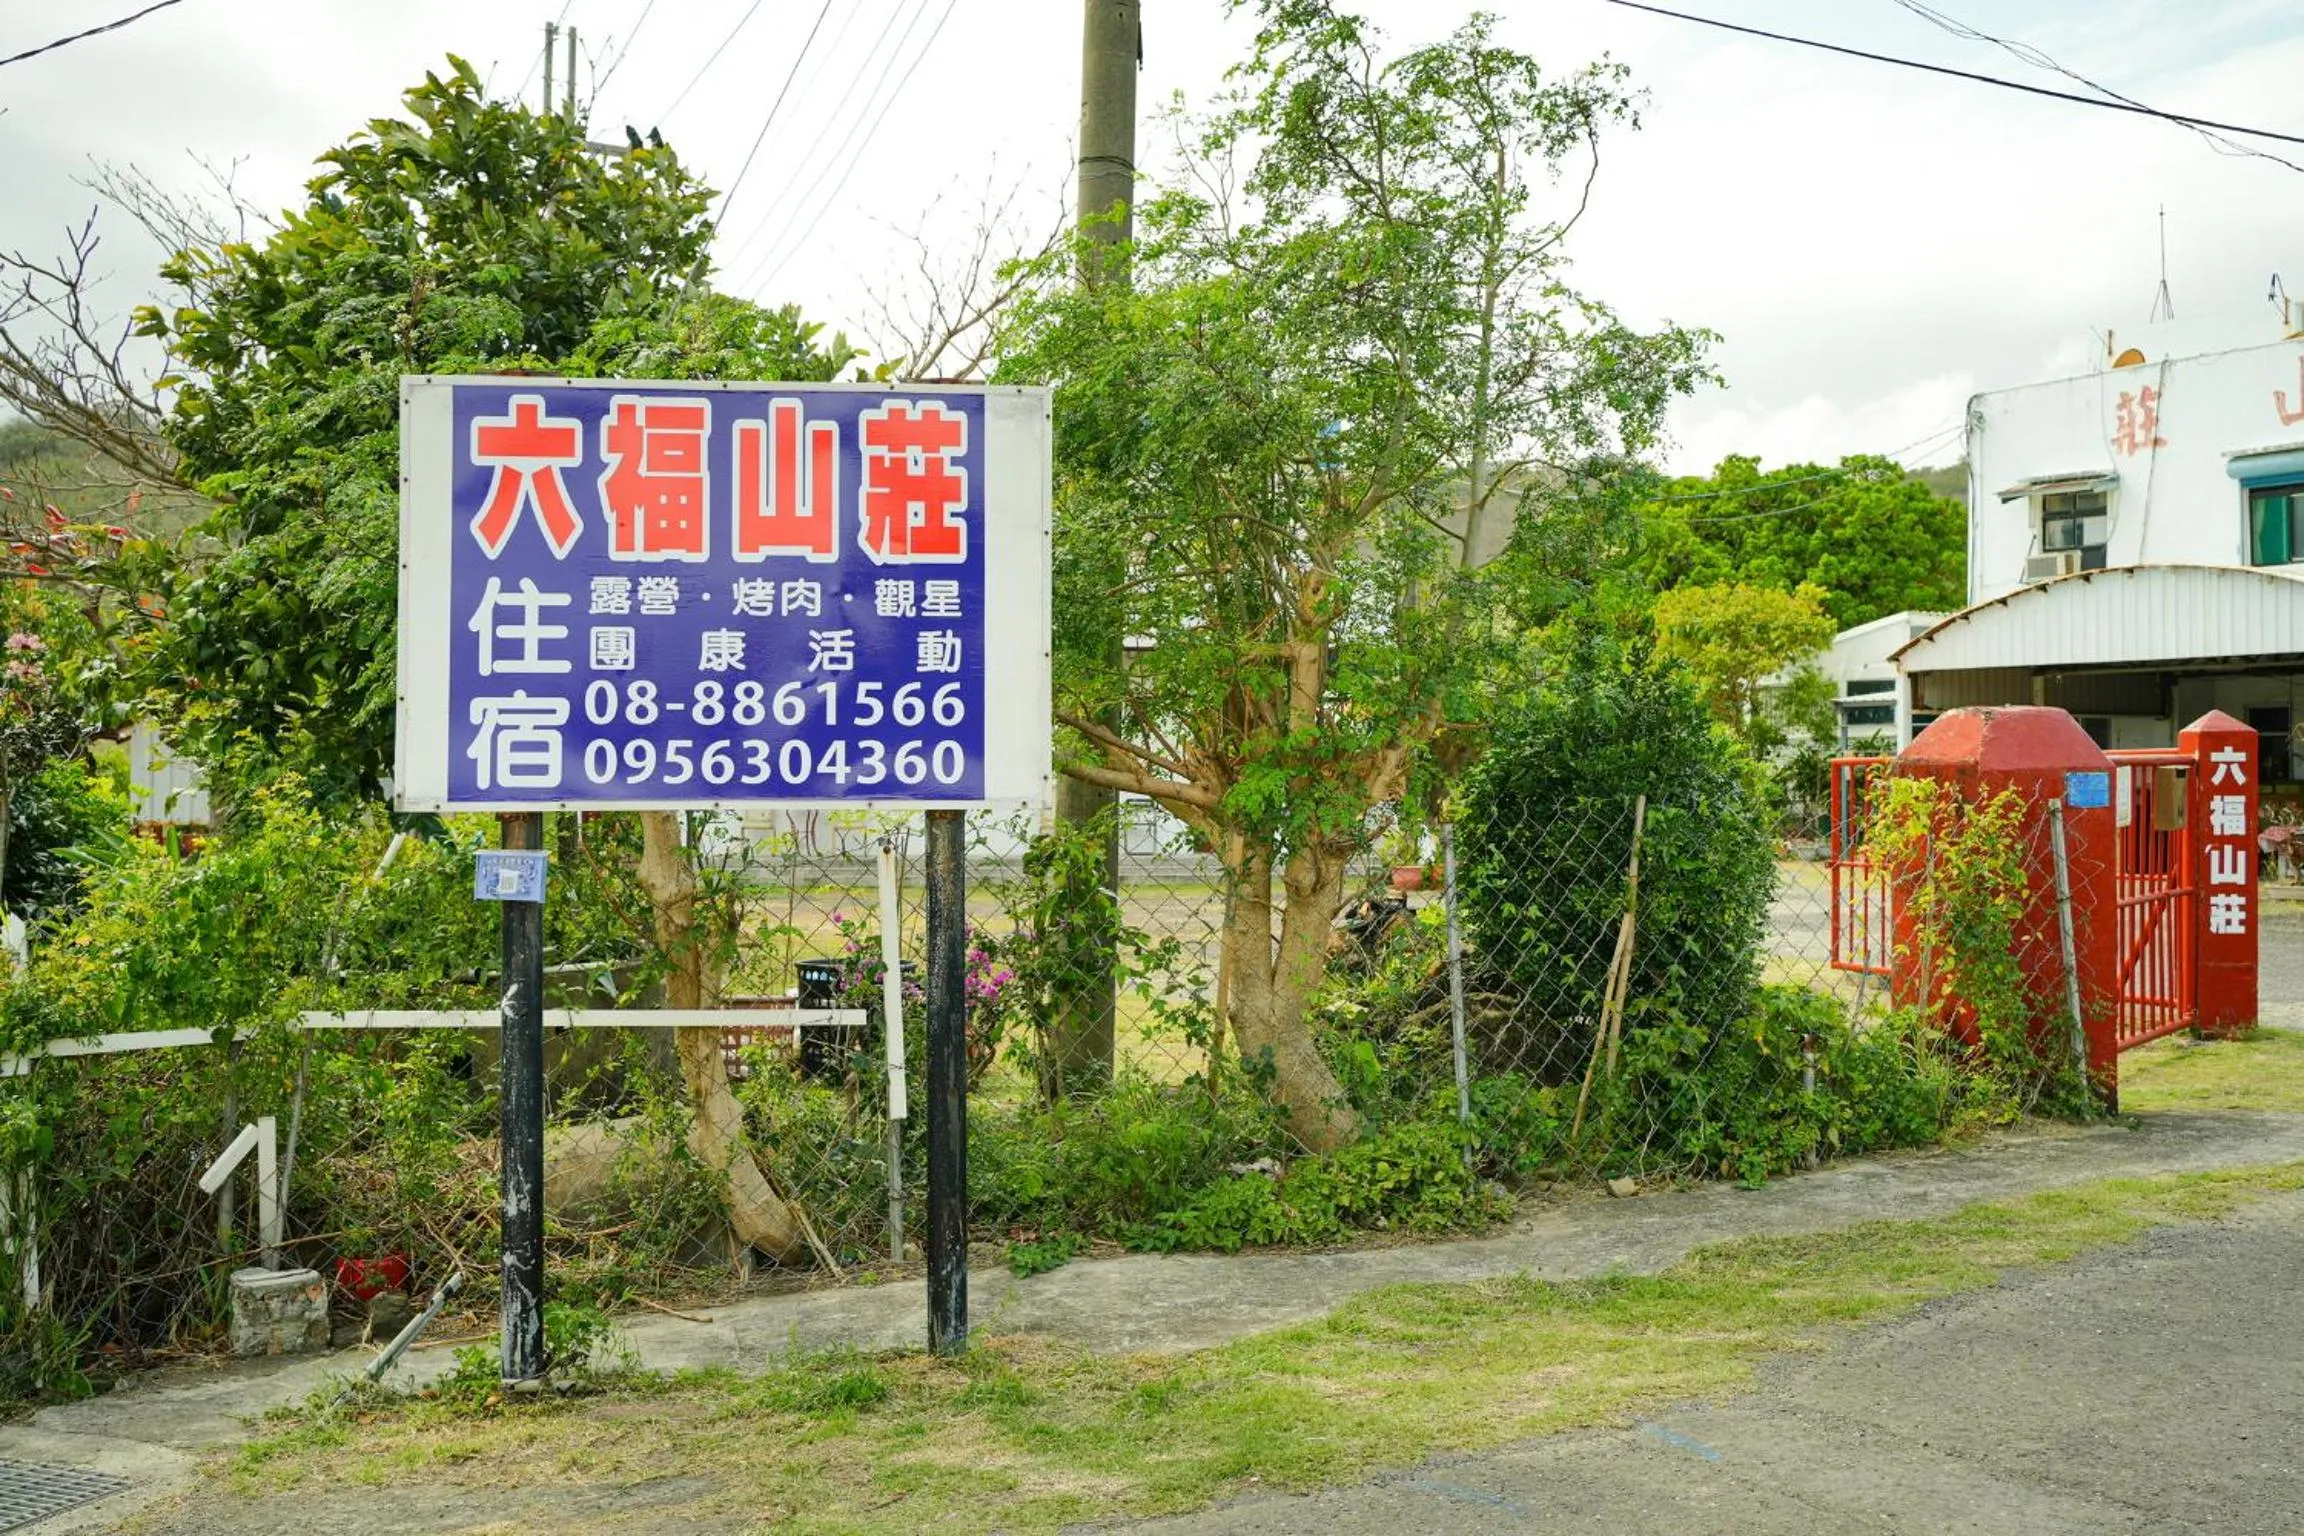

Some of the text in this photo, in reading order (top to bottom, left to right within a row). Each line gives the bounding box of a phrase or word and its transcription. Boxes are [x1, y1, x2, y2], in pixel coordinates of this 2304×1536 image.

[469, 393, 968, 565] 六福山莊
[589, 626, 963, 674] 團康活動
[467, 575, 573, 790] 住宿
[583, 680, 966, 727] 08-8861566
[583, 739, 966, 785] 0956304360
